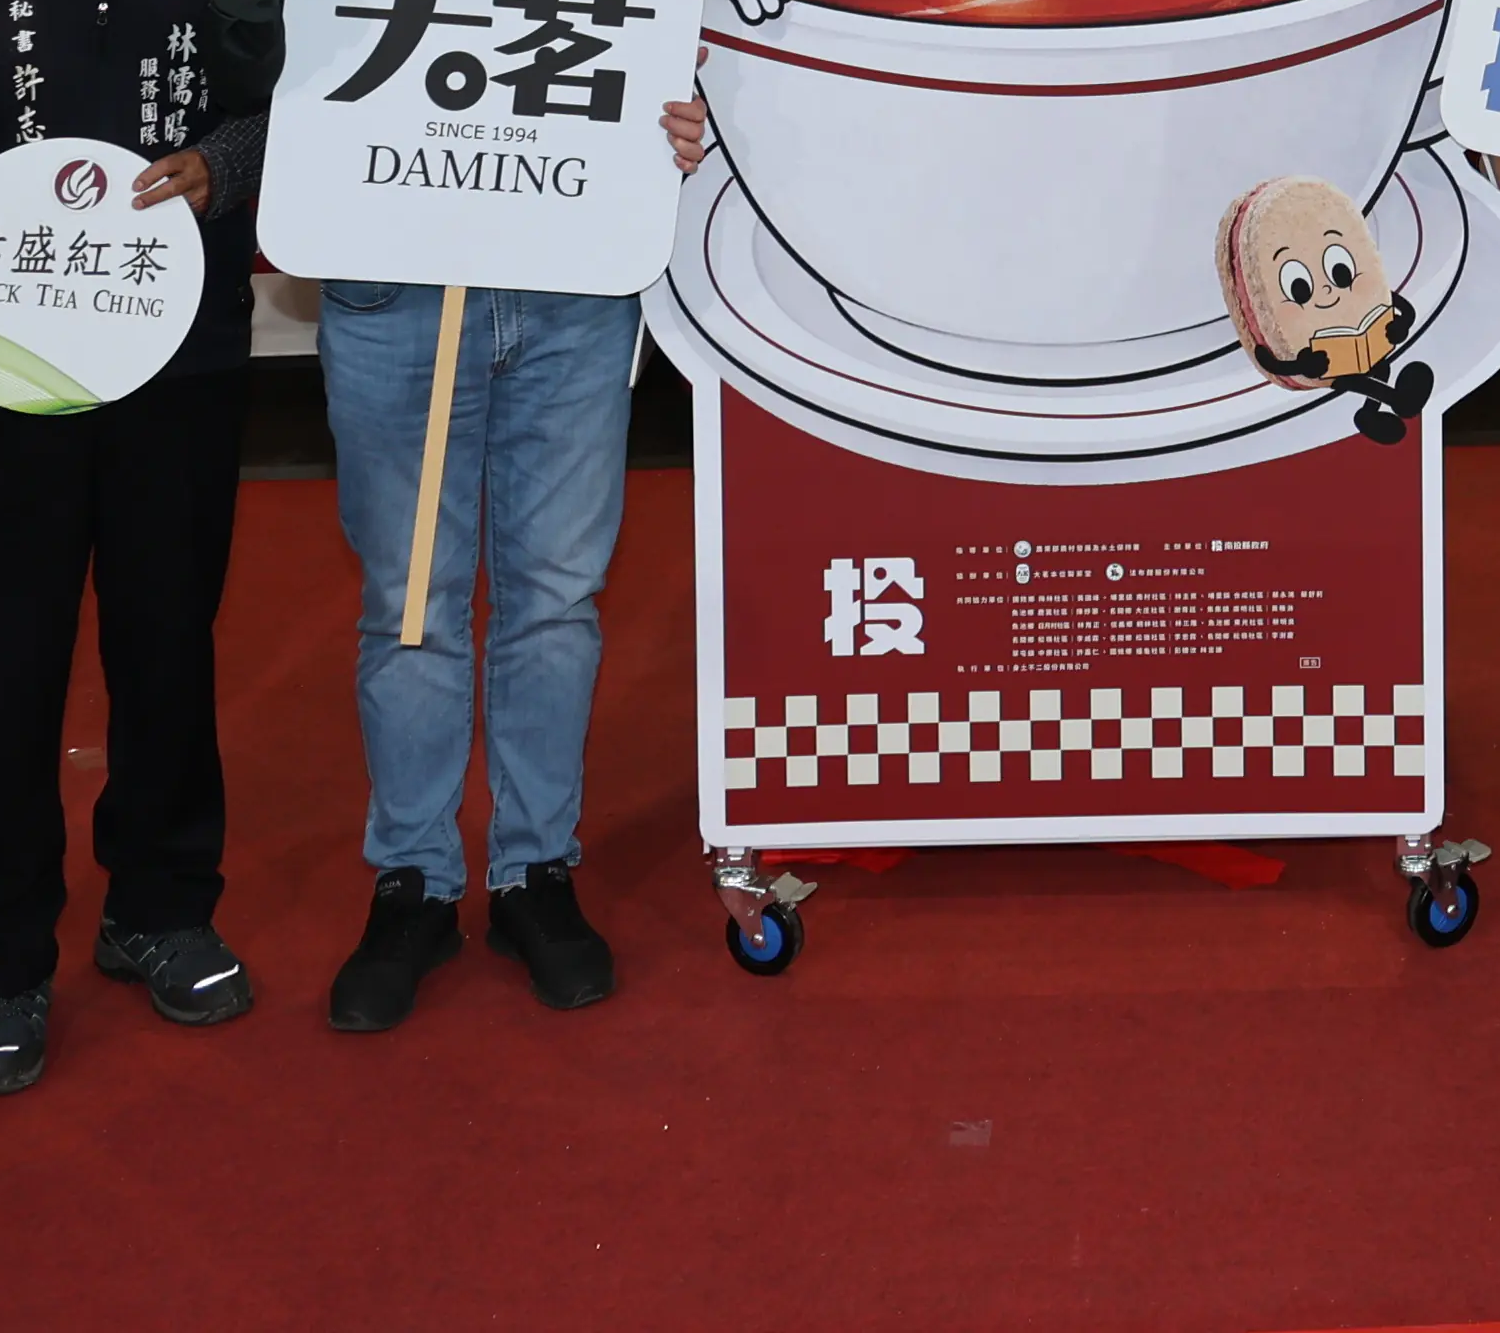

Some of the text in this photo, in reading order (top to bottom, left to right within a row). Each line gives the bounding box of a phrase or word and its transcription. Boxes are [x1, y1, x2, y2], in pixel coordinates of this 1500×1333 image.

[8, 0, 37, 53] 秘書
[138, 57, 161, 146] 服務團隊
[424, 121, 539, 144] SINCE 1994
[362, 144, 589, 198] DAMING
[36, 282, 80, 310] TEA
[92, 288, 165, 319] CHING
